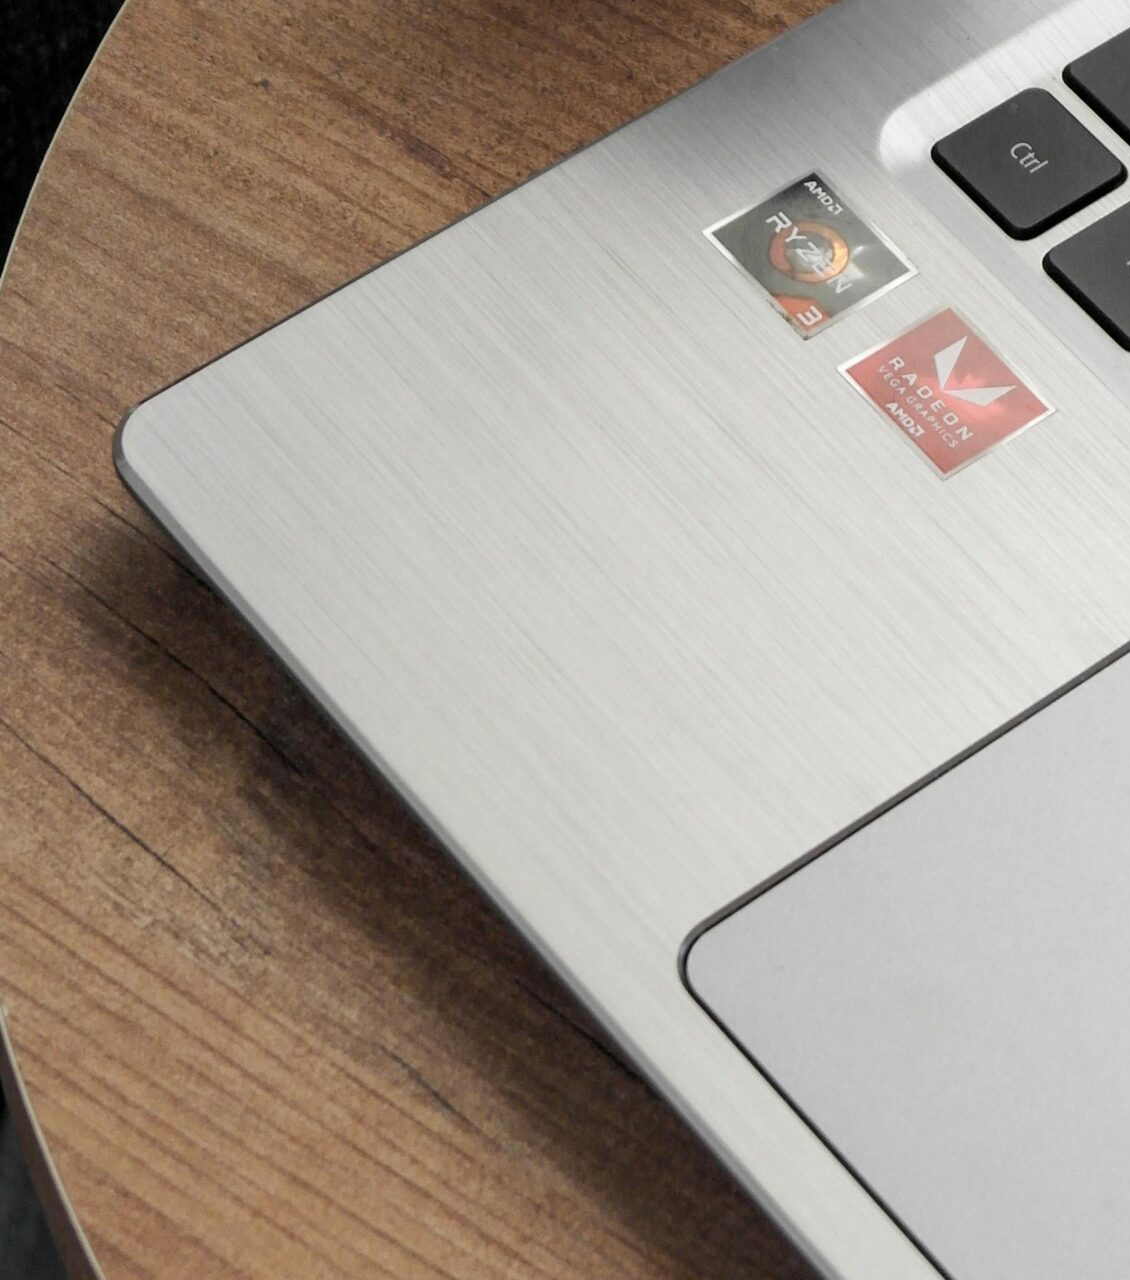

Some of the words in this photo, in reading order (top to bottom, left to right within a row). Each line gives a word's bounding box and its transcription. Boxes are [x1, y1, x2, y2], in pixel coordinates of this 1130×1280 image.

[1010, 142, 1049, 174] Ctrl
[803, 180, 835, 208] AMD
[766, 211, 852, 294] RYZEN
[797, 305, 823, 326] 3
[878, 366, 906, 395] VEGA
[906, 395, 958, 448] GRAPHICS
[889, 356, 973, 440] RADEON
[886, 402, 916, 429] AMD
